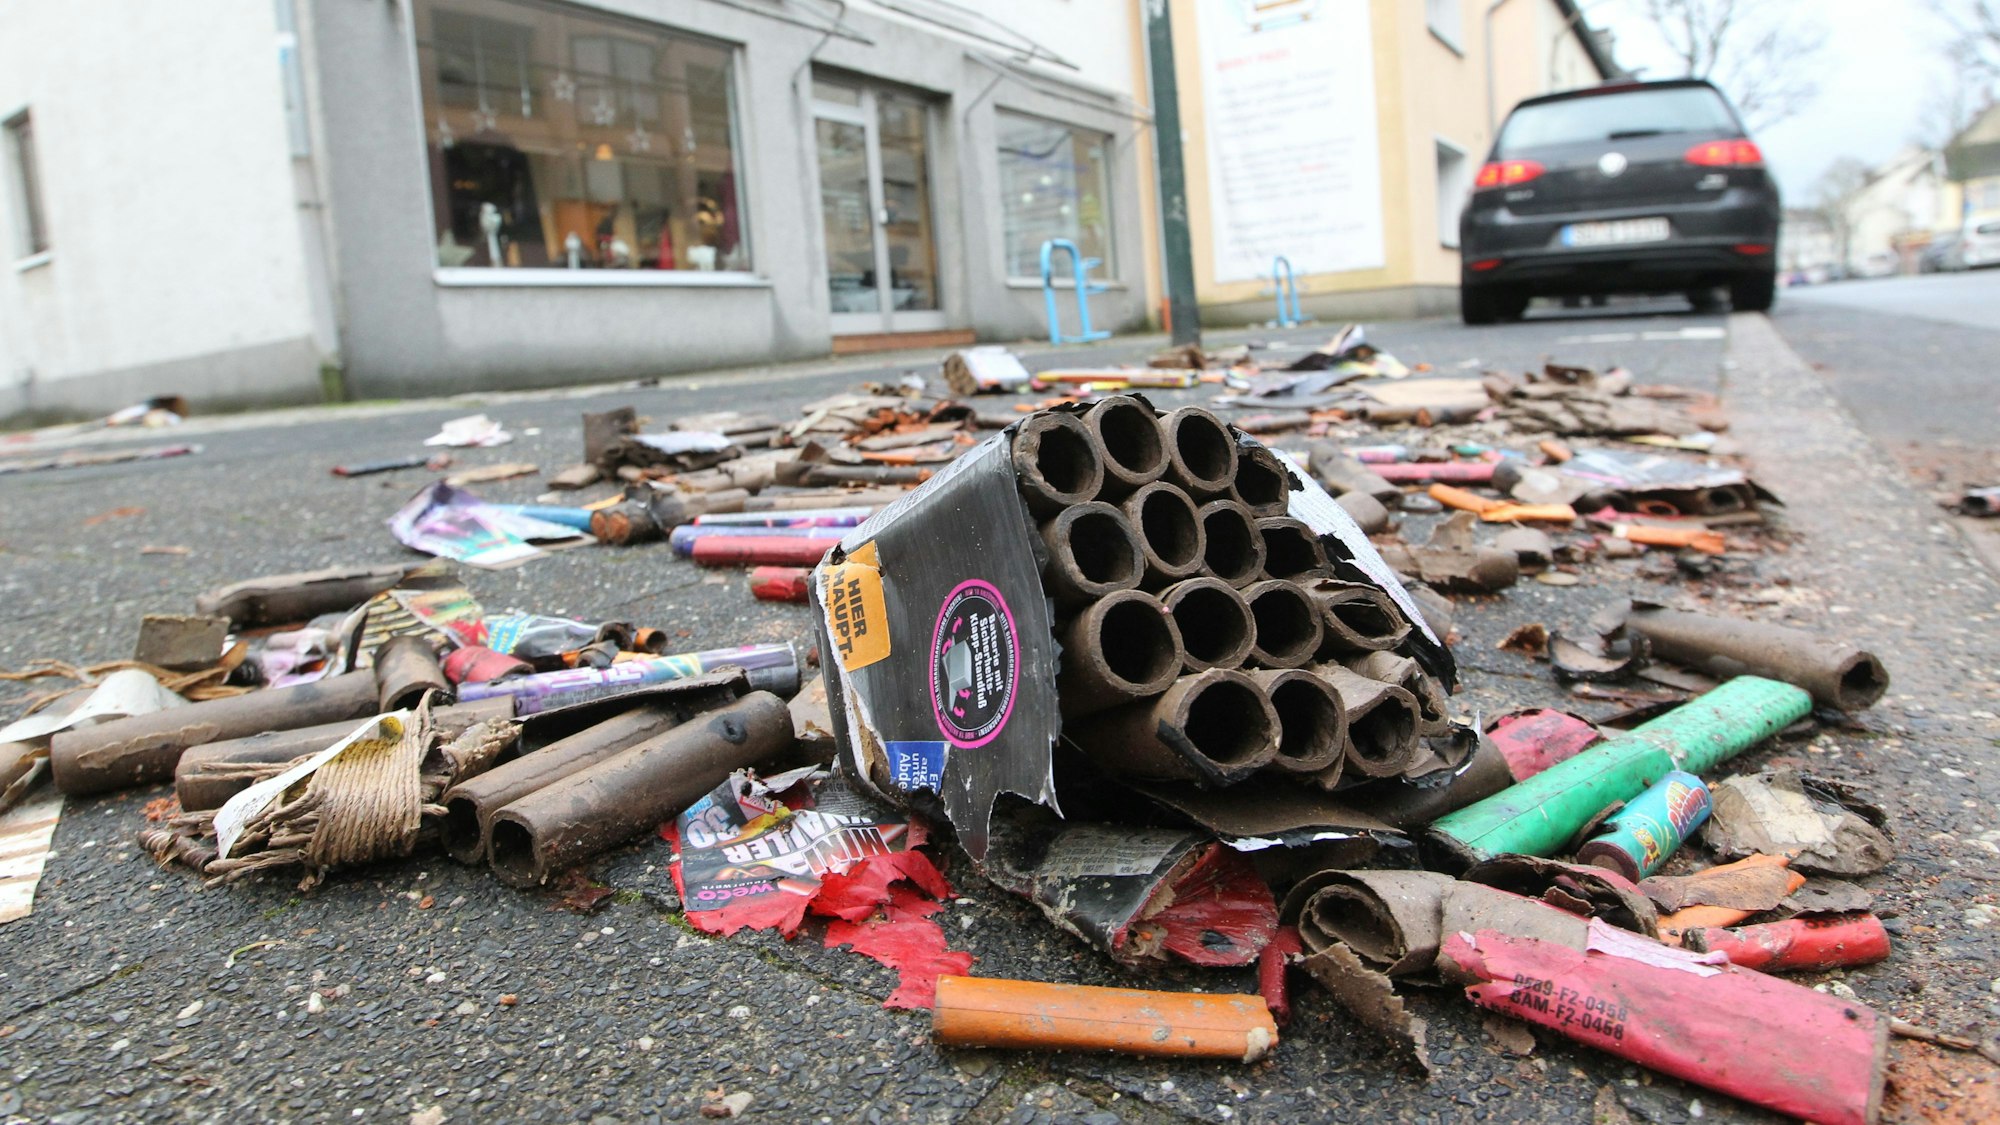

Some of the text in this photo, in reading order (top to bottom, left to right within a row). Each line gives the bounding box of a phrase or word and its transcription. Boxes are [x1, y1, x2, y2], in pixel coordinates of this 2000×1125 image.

[833, 569, 855, 661] HAUPT-
[847, 578, 868, 639] HIER
[969, 612, 988, 709] Klapp-Standfuß
[979, 617, 994, 696] Sicherheits-
[988, 613, 1004, 693] Batterie mit
[686, 805, 740, 849] 30
[1510, 989, 1625, 1041] BAM-F2-0458
